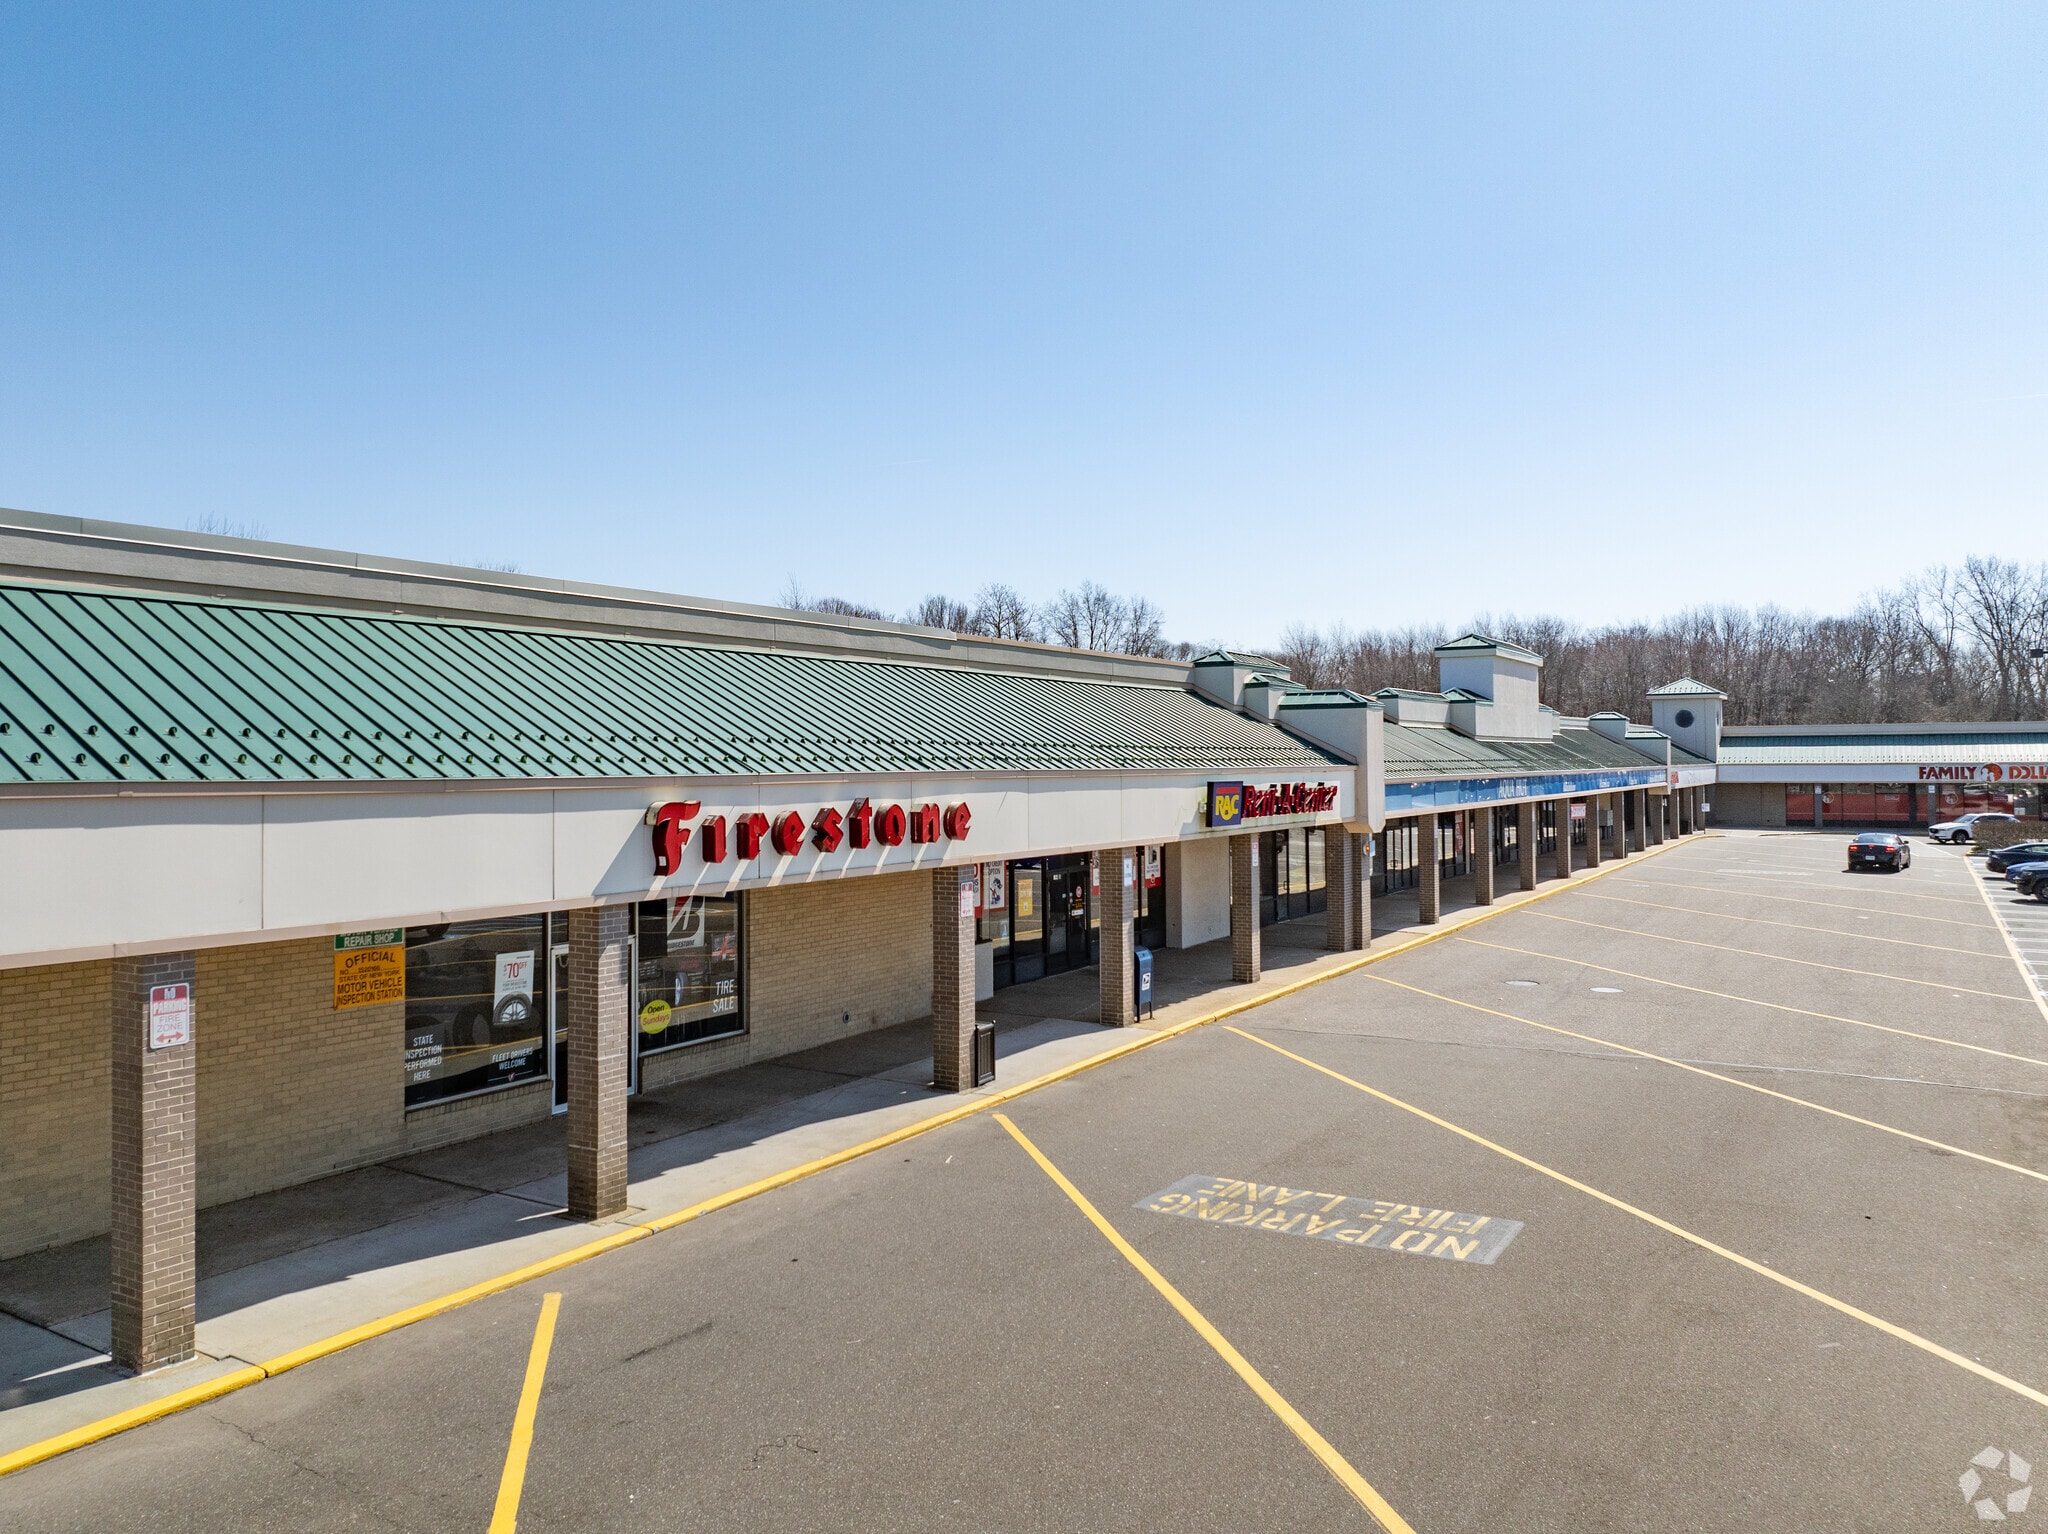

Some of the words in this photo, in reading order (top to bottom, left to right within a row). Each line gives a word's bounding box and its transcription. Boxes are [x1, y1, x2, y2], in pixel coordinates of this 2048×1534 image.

[1919, 766, 1977, 780] FAMILY
[1215, 794, 1240, 821] RAC
[645, 797, 972, 877] Firestone
[344, 935, 372, 948] REPAIR
[374, 932, 395, 944] SHOP
[345, 951, 396, 968] OFFICIAL
[337, 981, 367, 994] MOTOR
[369, 976, 402, 990] VEHICLE
[716, 978, 735, 996] TIRE
[336, 991, 375, 1006] INSPECTION
[377, 987, 403, 1001] STATION
[712, 996, 735, 1013] SALE
[160, 1014, 181, 1024] FIRE
[647, 1005, 665, 1016] Open
[157, 1022, 183, 1033] ZONE
[642, 1014, 670, 1026] Sundays
[413, 1034, 434, 1047] STATE
[405, 1044, 443, 1059] NSPECTION
[491, 1051, 510, 1064] FLEET
[510, 1046, 534, 1060] DRIVERS
[498, 1057, 527, 1070] WELCOME
[413, 1069, 431, 1081] HERE
[1197, 1177, 1347, 1212] LANE
[1149, 1192, 1384, 1243] PARKING
[1359, 1201, 1491, 1236] FIRE
[1390, 1228, 1481, 1260] NO
